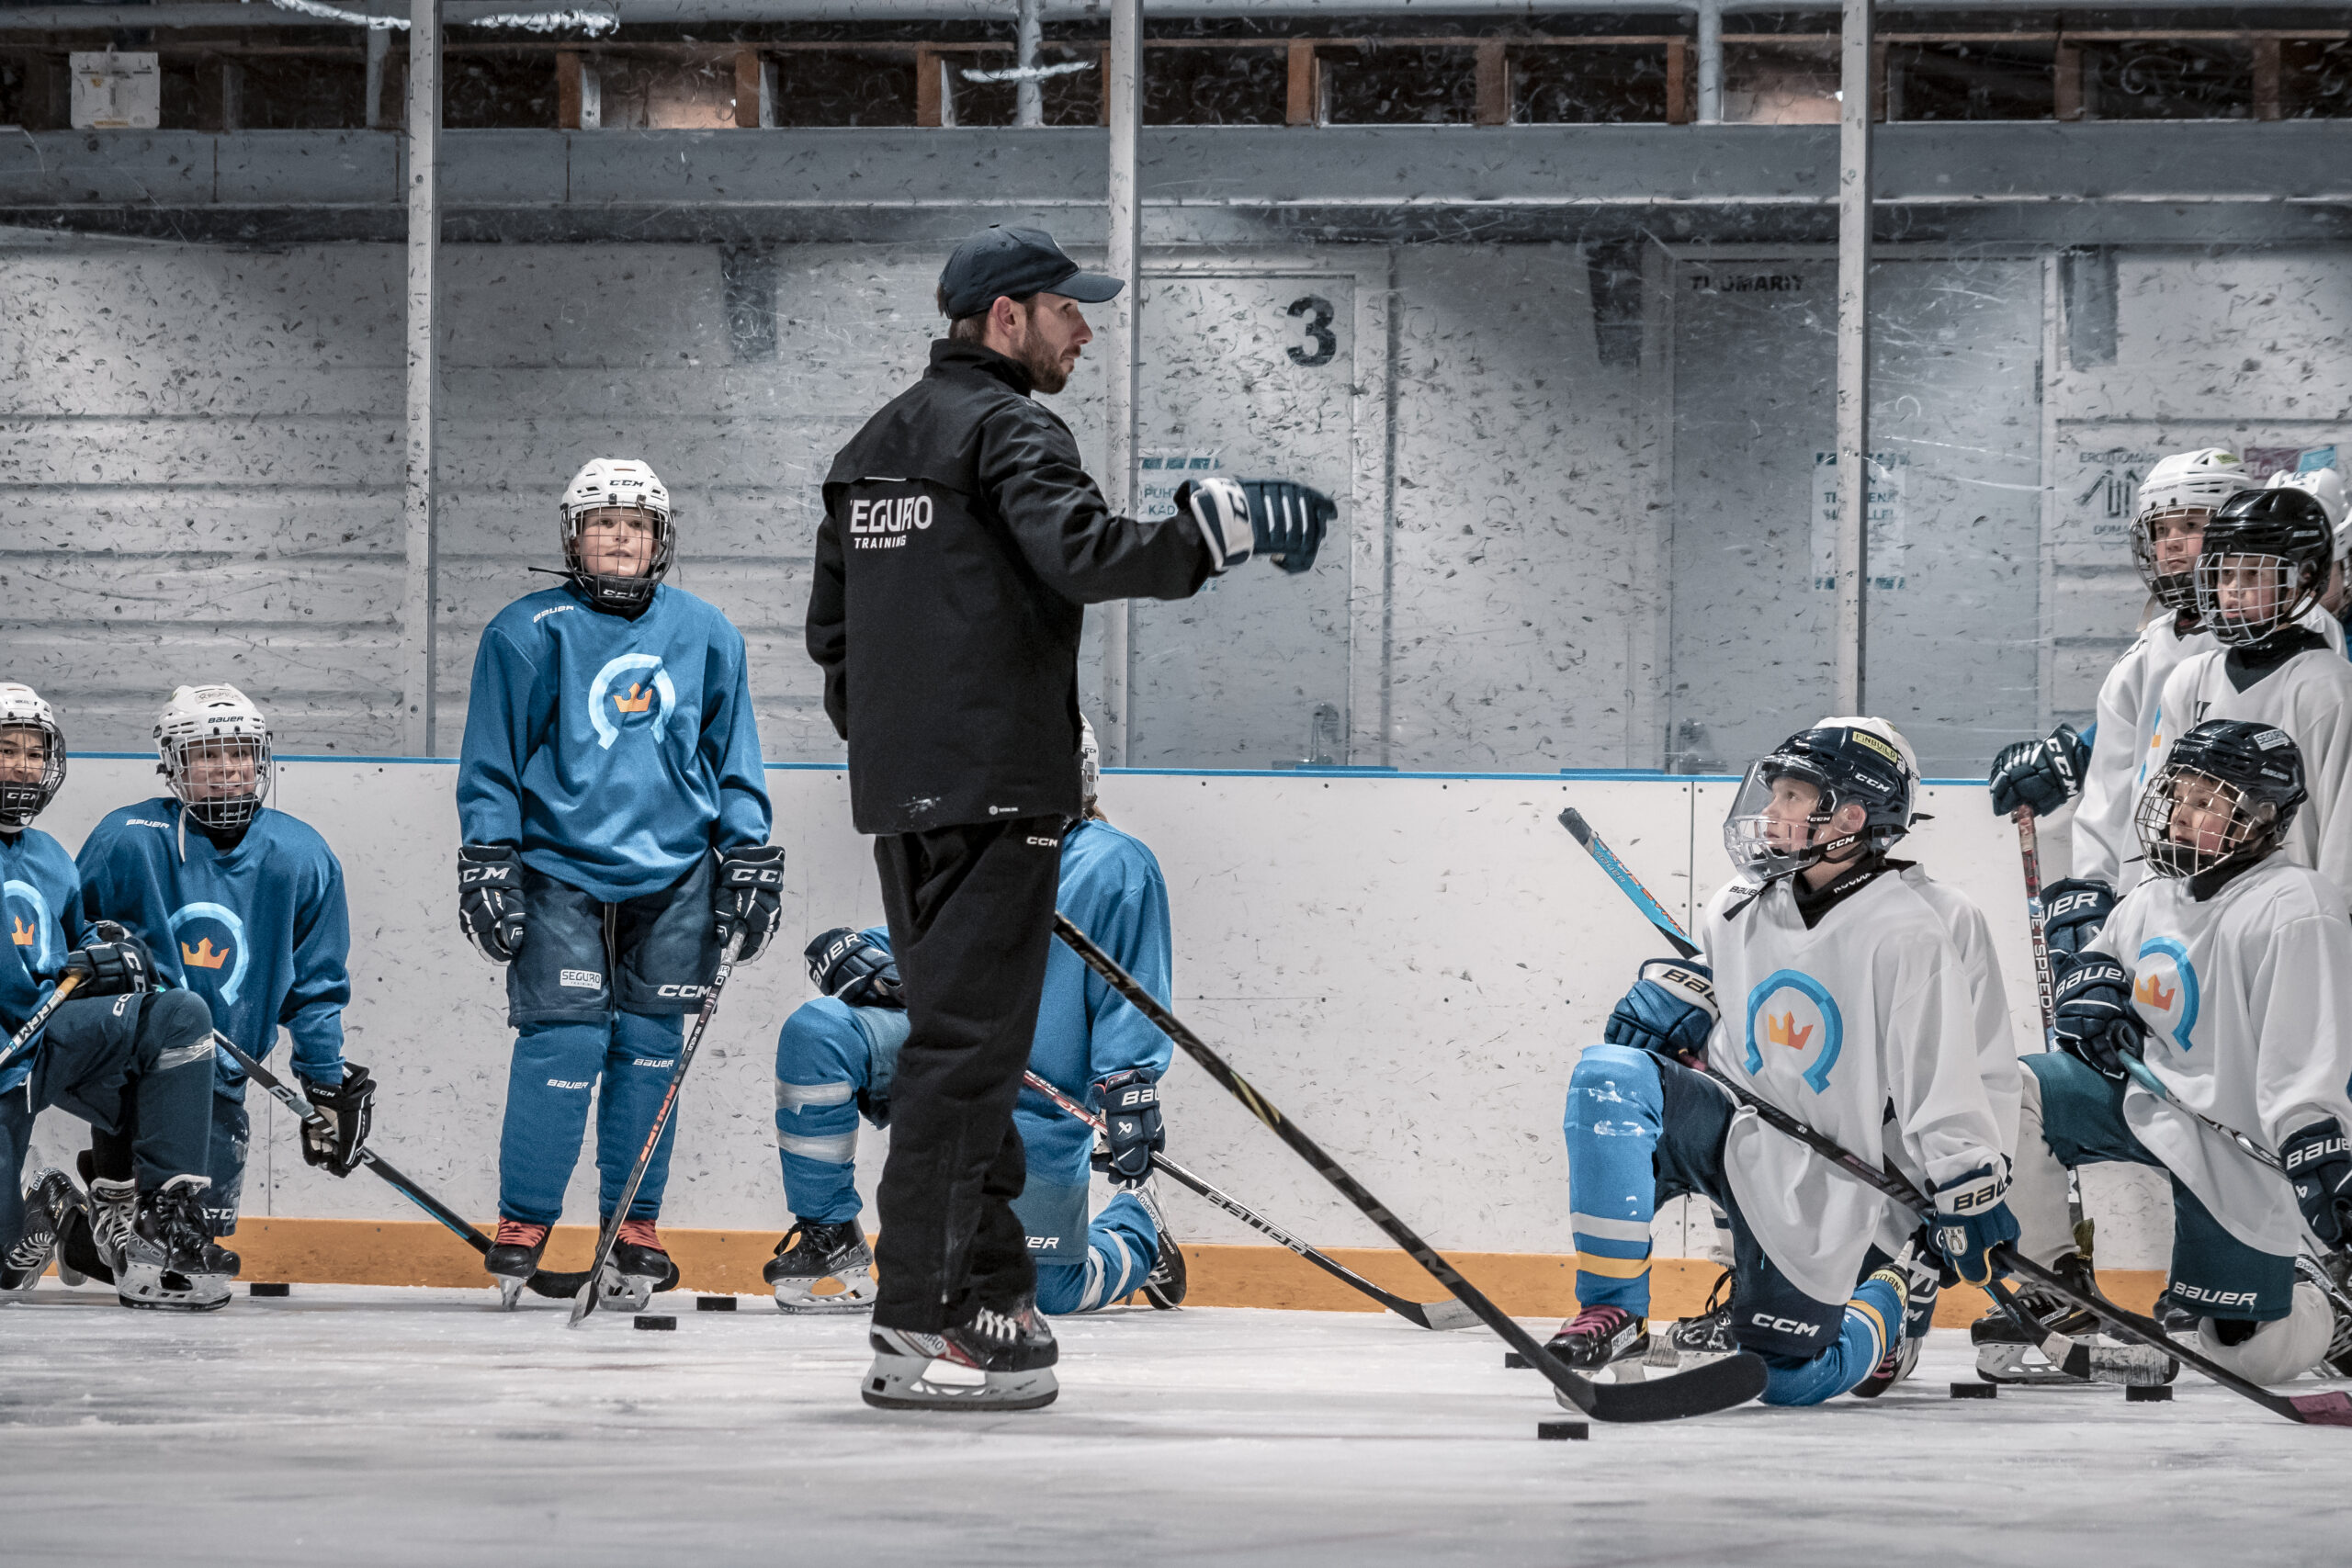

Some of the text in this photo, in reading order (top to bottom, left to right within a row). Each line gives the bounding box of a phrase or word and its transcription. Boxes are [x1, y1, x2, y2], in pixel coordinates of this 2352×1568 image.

[1286, 295, 1337, 367] 3
[850, 495, 933, 533] EGURO
[854, 535, 907, 549] TRAINING
[603, 589, 641, 599] CCM
[533, 605, 574, 624] BAUER
[208, 716, 244, 724] BAUER
[2044, 737, 2080, 796] CCM
[1855, 772, 1891, 793] CCM
[125, 818, 170, 829] BAUER
[1026, 835, 1058, 848] CCM
[1826, 836, 1855, 852] CCM
[459, 867, 510, 883] CM
[731, 868, 784, 885] CC
[2030, 913, 2052, 1009] JETSPEED
[122, 950, 147, 994] CC
[561, 971, 601, 984] SEGURO
[2055, 965, 2126, 1000] BAUE
[657, 985, 713, 998] CCM
[633, 1058, 674, 1068] BAUER
[547, 1079, 589, 1089] BAUER
[311, 1088, 336, 1098] CCM
[1140, 1196, 1162, 1232] SEGURO
[1204, 1191, 1306, 1256] BAUER
[1024, 1235, 1059, 1250] ER
[2172, 1281, 2257, 1307] BAUER
[1750, 1313, 1821, 1337] CCM
